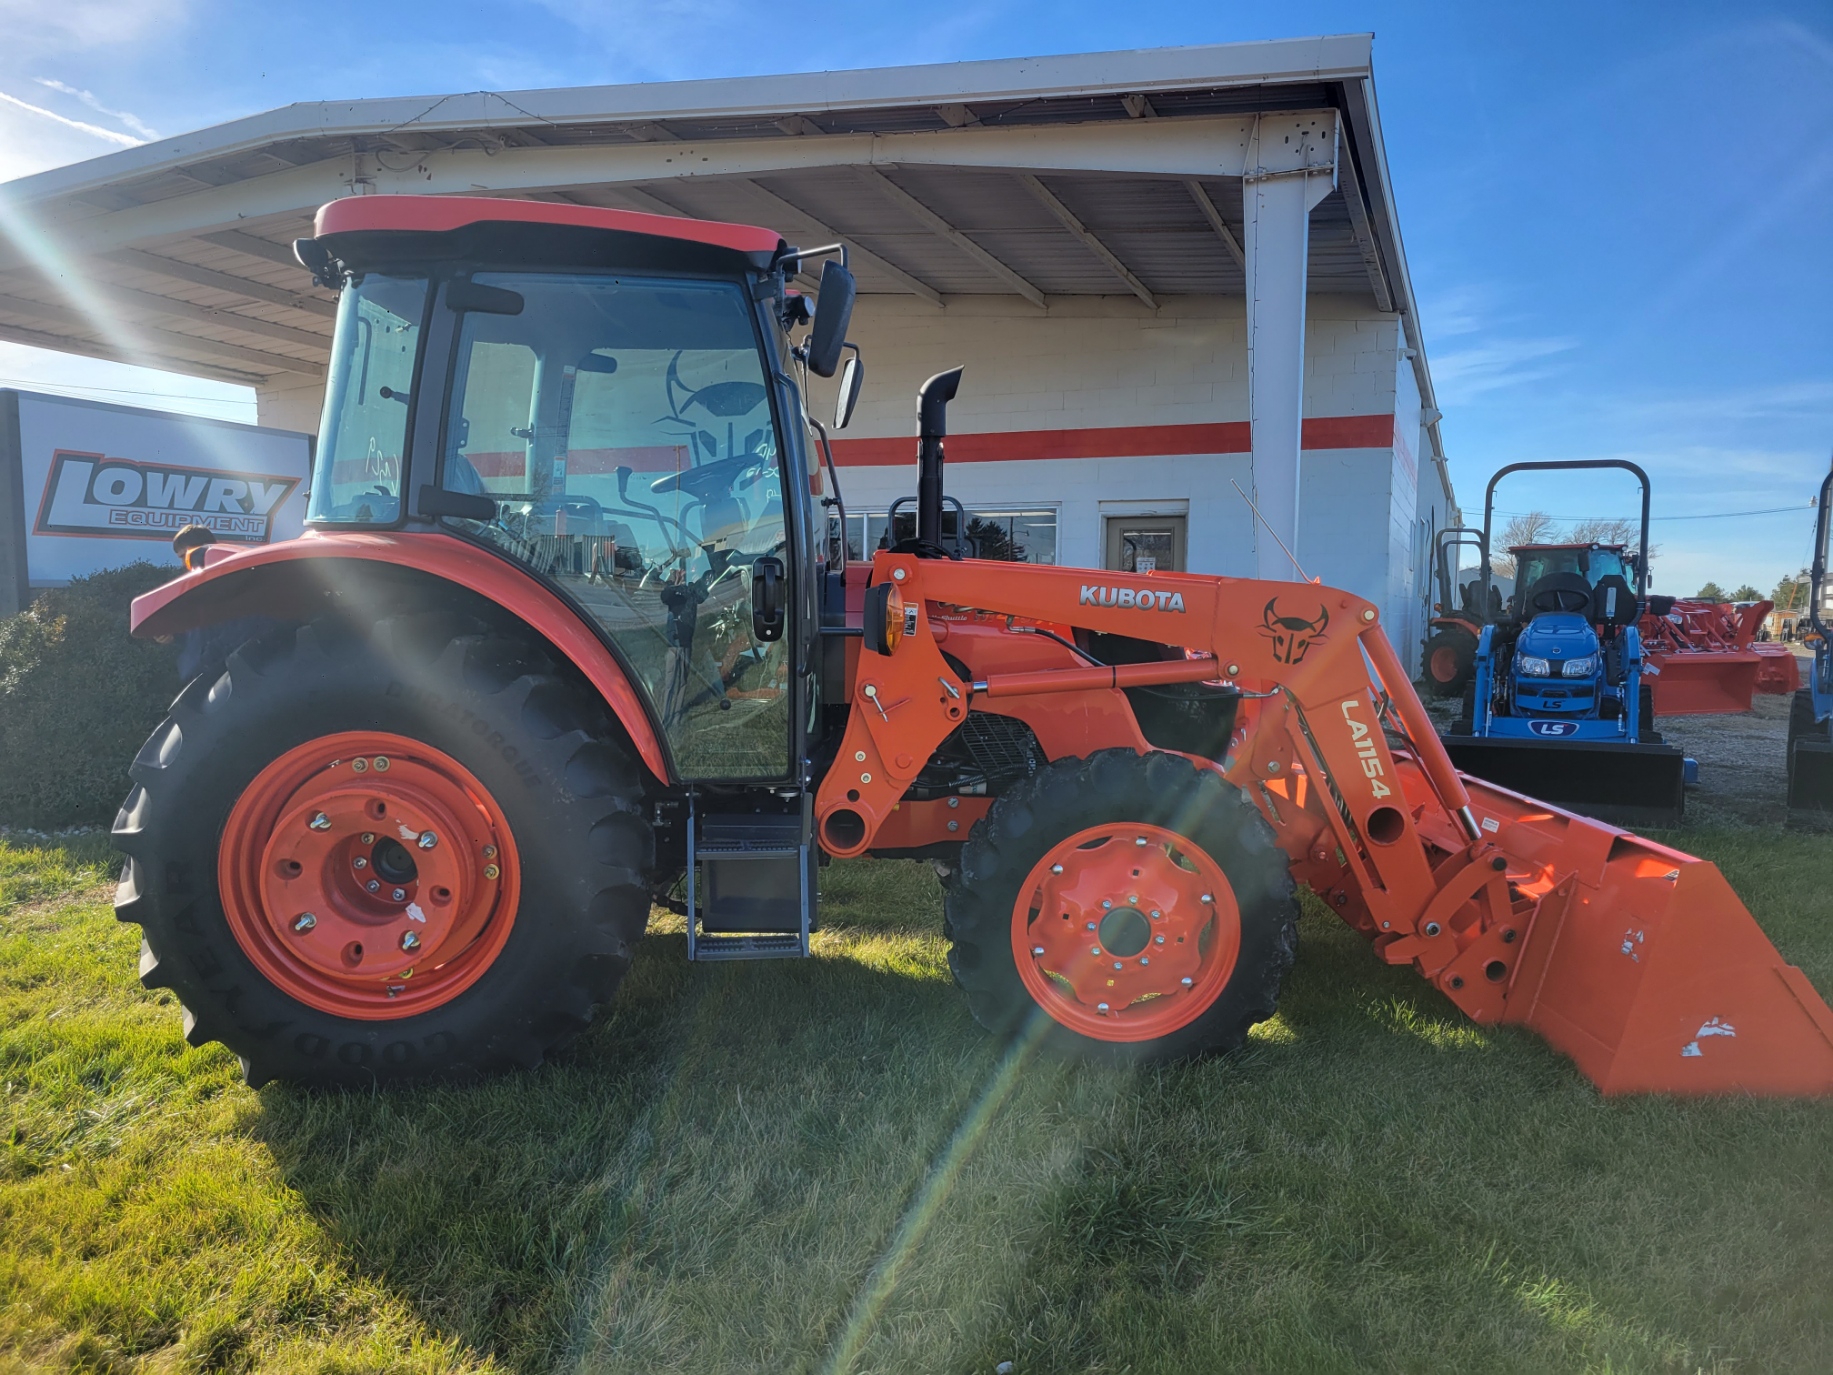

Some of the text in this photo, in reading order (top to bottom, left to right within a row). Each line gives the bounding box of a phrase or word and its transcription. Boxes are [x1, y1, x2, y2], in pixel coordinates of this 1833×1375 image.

[47, 459, 289, 528] LOWRY
[109, 508, 265, 532] EQUIPMENT
[1079, 584, 1186, 613] KUBOTA
[1542, 700, 1563, 709] LS
[1540, 723, 1565, 735] LS
[1341, 700, 1391, 799] LA1154
